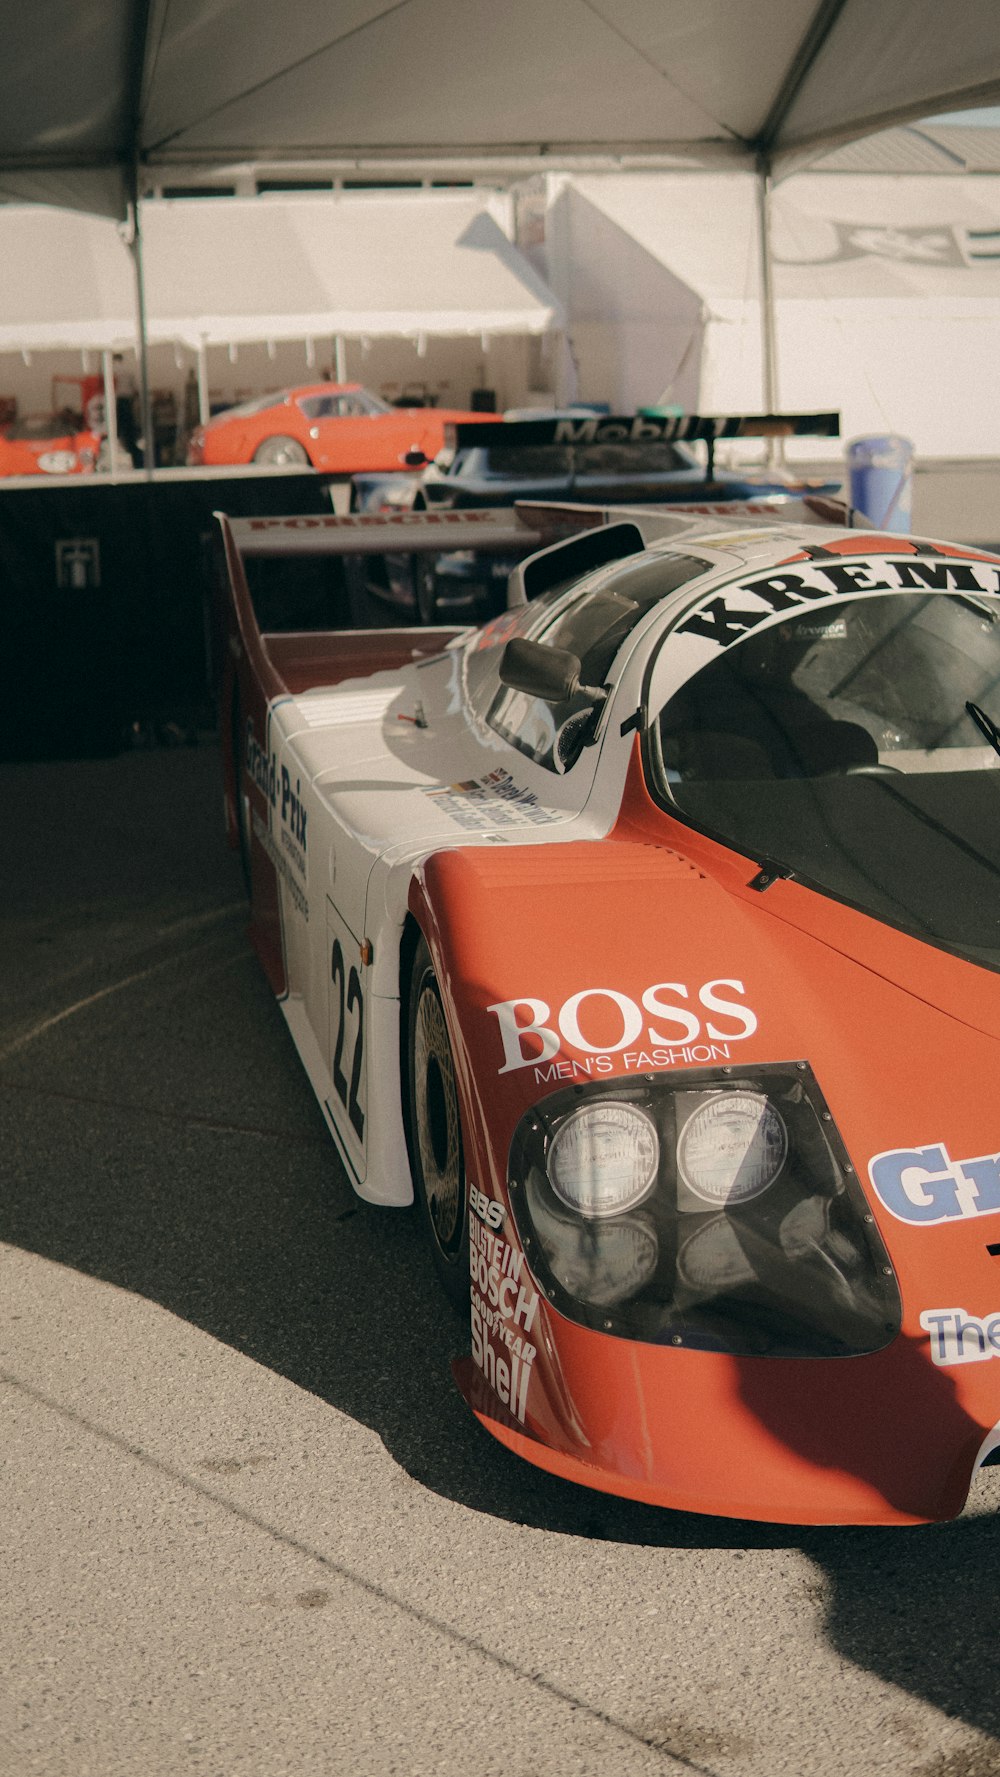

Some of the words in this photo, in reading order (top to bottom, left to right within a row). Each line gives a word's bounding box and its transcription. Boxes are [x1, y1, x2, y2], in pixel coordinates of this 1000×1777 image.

[554, 416, 692, 443] Mobil
[250, 511, 497, 530] PORSCHE
[673, 561, 1000, 647] KREM
[490, 776, 529, 801] Derek
[331, 938, 365, 1144] 22
[486, 979, 757, 1075] BOSS
[534, 1055, 613, 1085] MEN'S
[623, 1043, 731, 1070] FASHION
[469, 1183, 506, 1229] BBS
[469, 1210, 524, 1282] BILSTEIN
[469, 1240, 539, 1332] BOSCH
[471, 1304, 531, 1424] Shell
